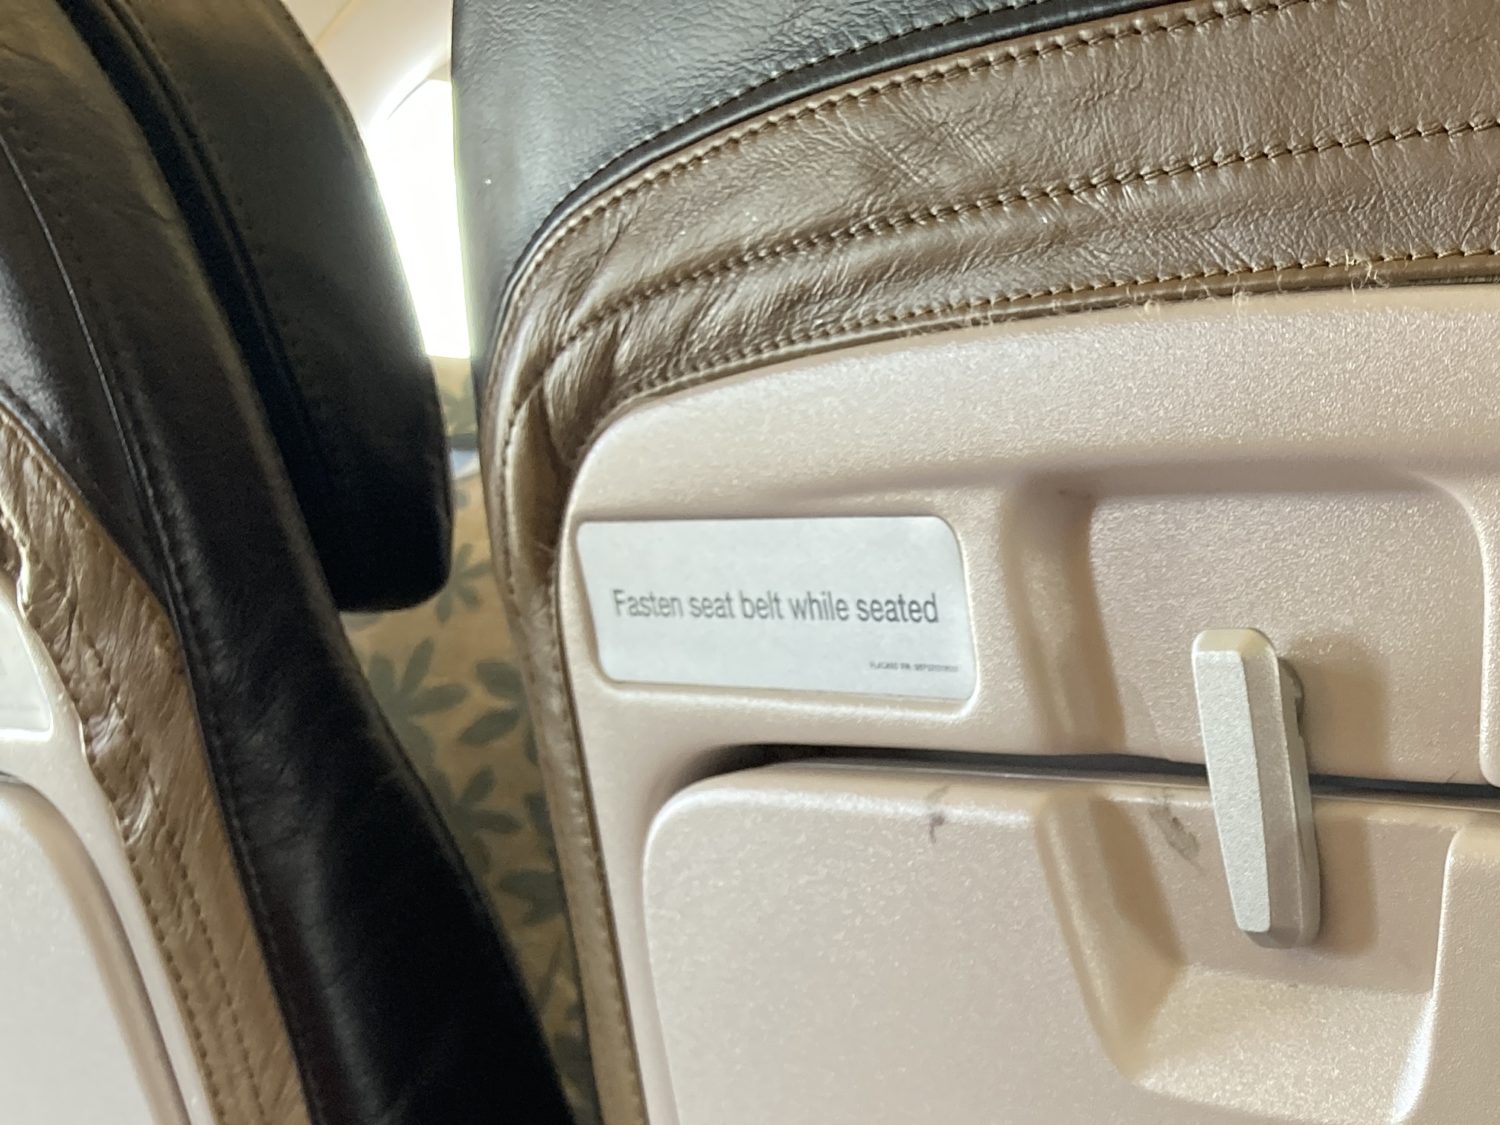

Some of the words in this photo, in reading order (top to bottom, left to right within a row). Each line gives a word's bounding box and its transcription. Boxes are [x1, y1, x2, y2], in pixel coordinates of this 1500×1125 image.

[611, 588, 685, 618] Fasten
[688, 590, 736, 619] seat
[738, 589, 785, 620] belt
[788, 590, 850, 622] while
[856, 592, 940, 624] seated
